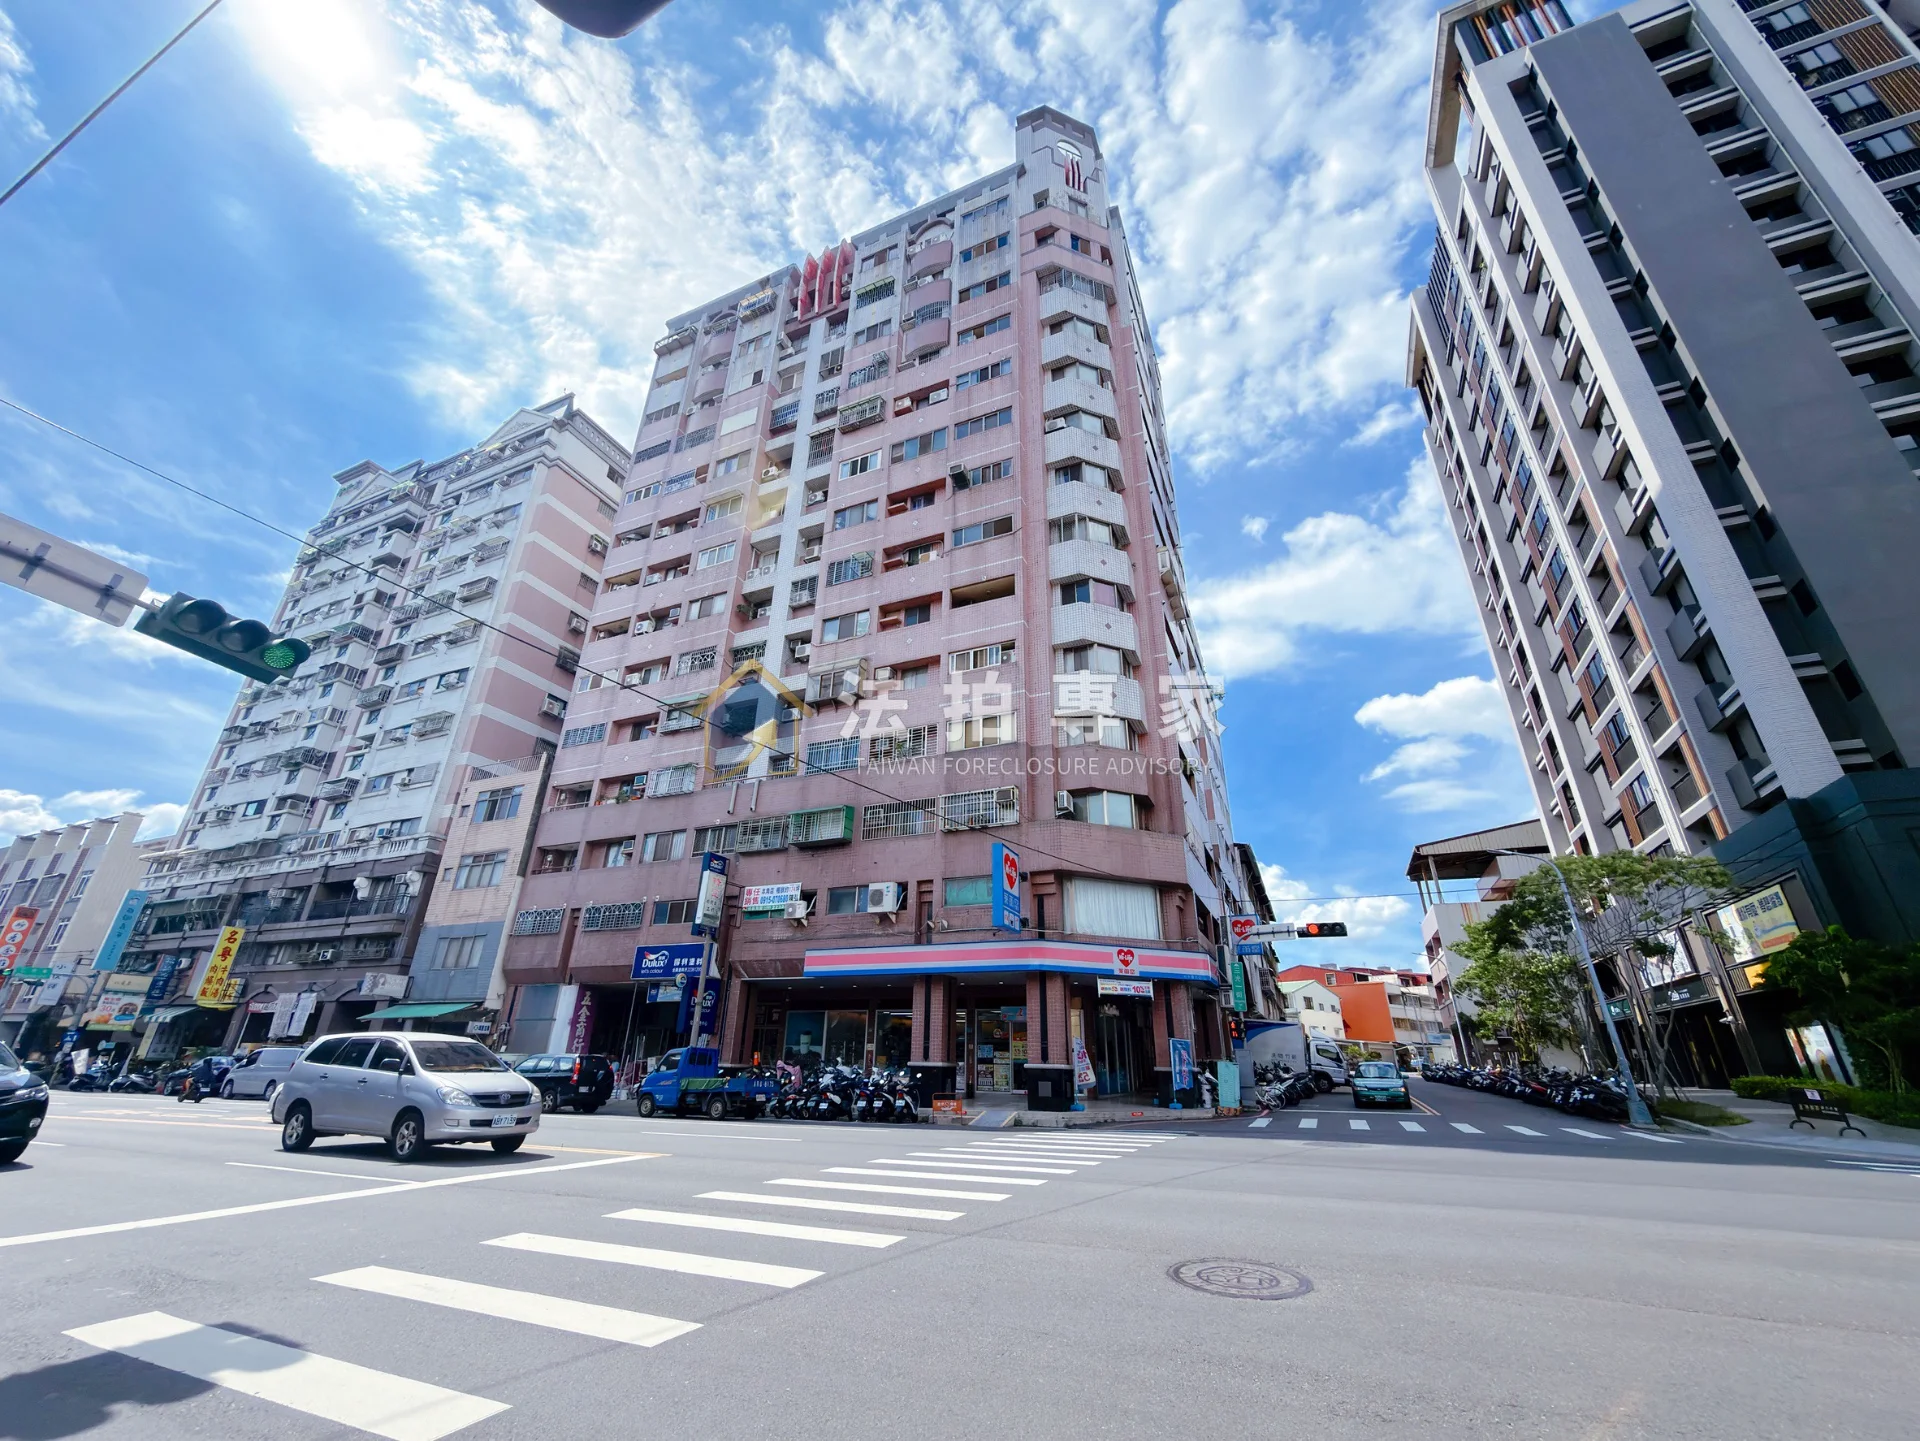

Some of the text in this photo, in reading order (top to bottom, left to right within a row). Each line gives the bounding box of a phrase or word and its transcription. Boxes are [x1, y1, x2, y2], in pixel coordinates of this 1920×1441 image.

[642, 958, 667, 968] Dulux
[572, 991, 591, 1054] 五金商行
